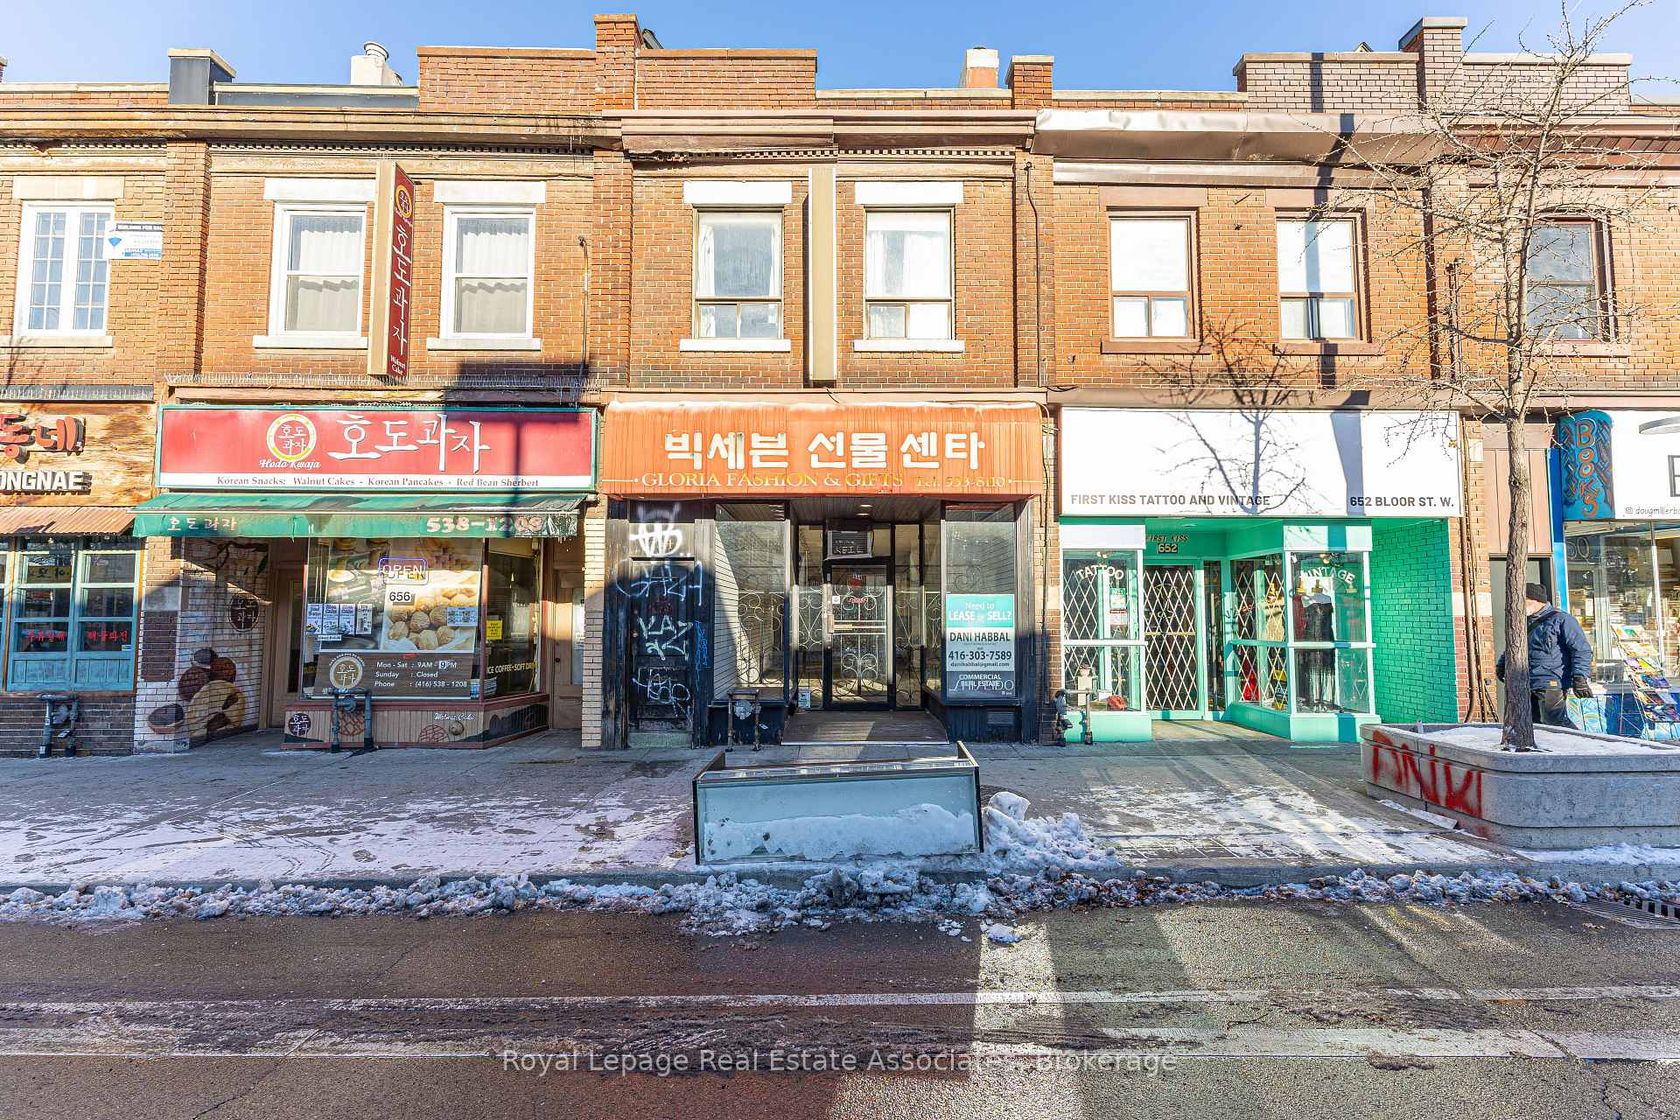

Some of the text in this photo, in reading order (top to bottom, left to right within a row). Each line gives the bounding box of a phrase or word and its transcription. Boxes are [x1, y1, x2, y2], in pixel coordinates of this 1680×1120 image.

[392, 224, 412, 355] 호도과자
[327, 413, 492, 474] 호도과자
[664, 431, 986, 470] 빅세븐 선물 센타
[1574, 418, 1599, 517] BOOKS
[216, 476, 250, 486] Korean
[251, 476, 287, 486] Snacks:
[293, 477, 326, 486] Walnut
[327, 477, 356, 486] Cakes
[368, 477, 400, 486] Korean
[402, 477, 444, 486] Pancakes
[456, 477, 474, 486] Red
[476, 477, 499, 487] Bean
[500, 478, 539, 487] Sherbert
[641, 472, 721, 487] GLORIA
[727, 472, 818, 487] FASHION
[823, 473, 841, 486] &
[845, 472, 903, 487] GIFTS
[1070, 494, 1271, 506] FIRST KISS TATTOO AND VINTAGE
[1349, 496, 1454, 507] 652 BLOOR ST. W.
[167, 516, 238, 532] 호도과자
[1157, 543, 1178, 553] 652
[383, 564, 423, 578] OPEN
[1076, 564, 1124, 580] TATTOO
[389, 591, 411, 602] 656
[965, 601, 995, 610] Need to
[948, 611, 976, 621] LEASE
[987, 611, 1012, 621] SELL?
[949, 632, 1011, 642] DANI HABBAL
[948, 650, 1012, 661] 416-303-7589
[439, 660, 458, 669] 9PM
[375, 671, 400, 679] Sunday
[414, 680, 432, 688] (416)
